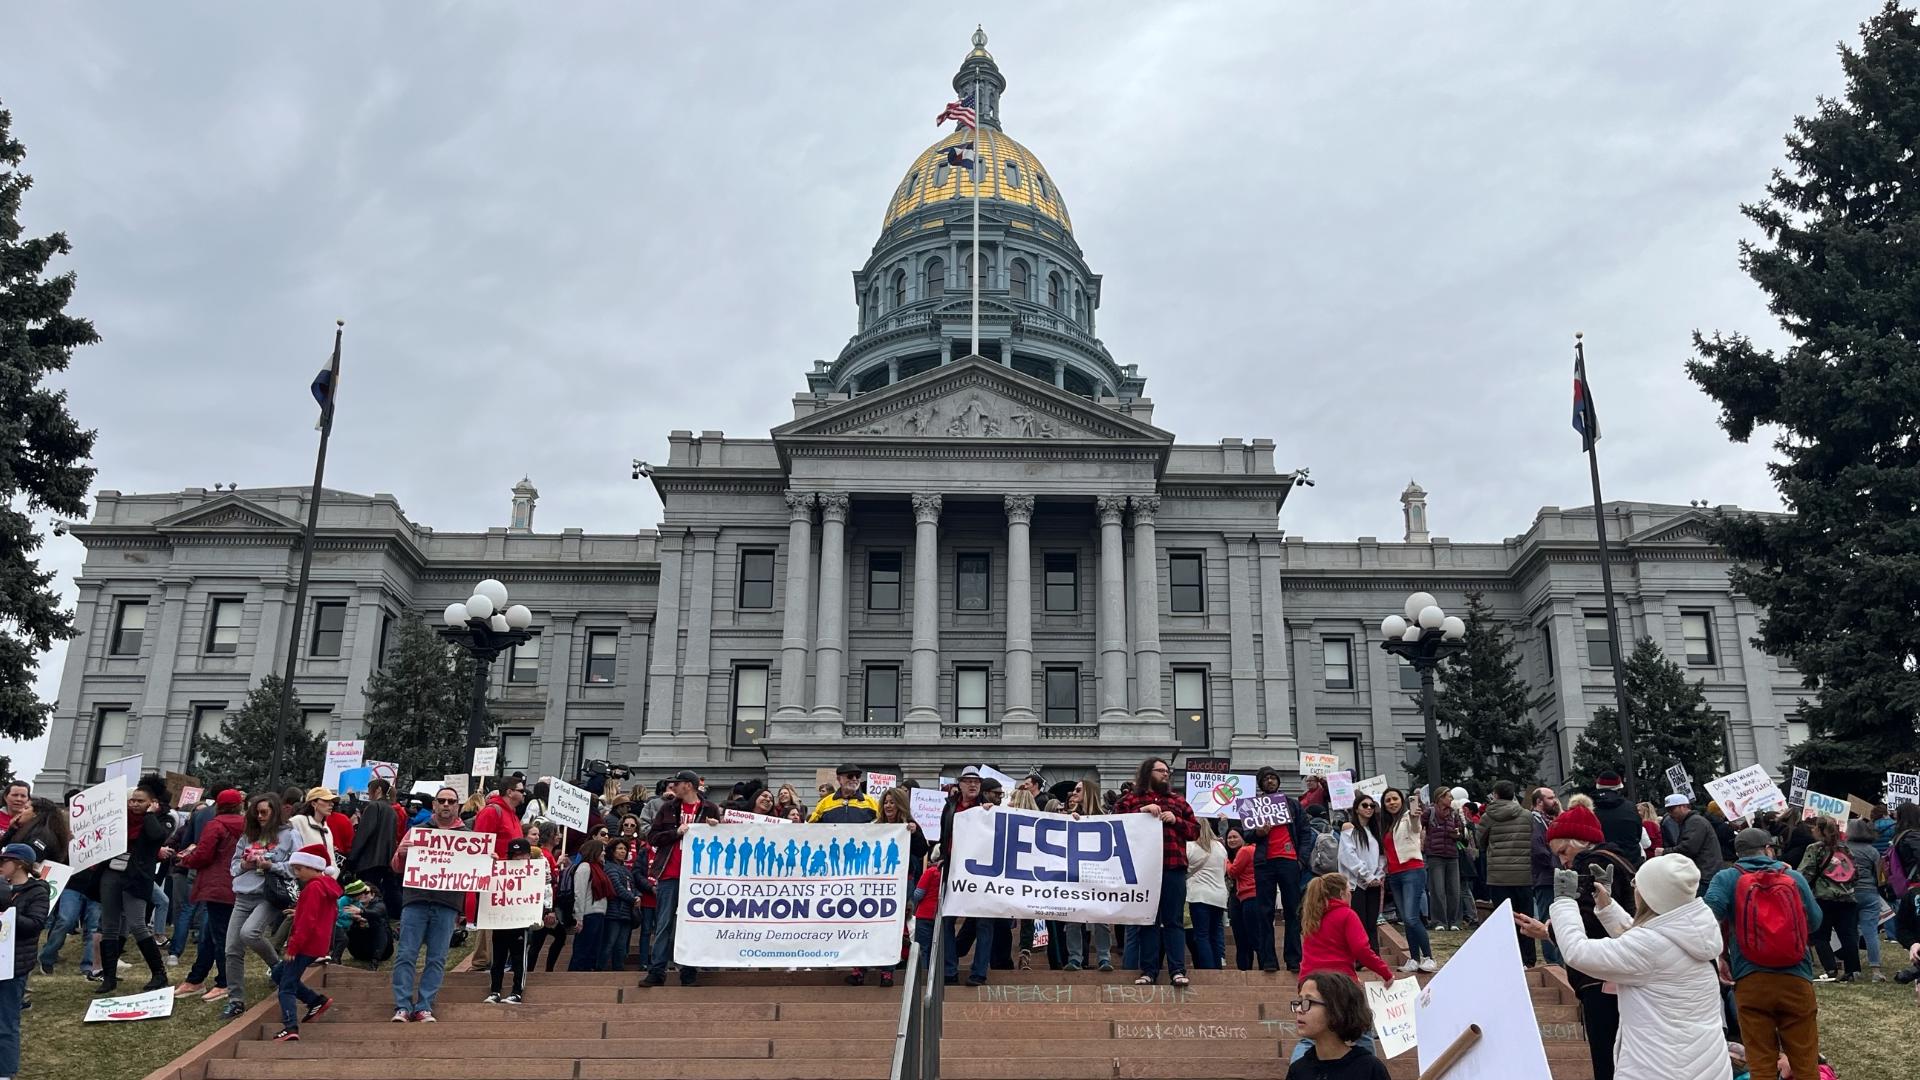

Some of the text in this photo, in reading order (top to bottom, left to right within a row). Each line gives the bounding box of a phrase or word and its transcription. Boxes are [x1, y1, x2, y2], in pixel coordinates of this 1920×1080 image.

[1187, 760, 1229, 771] Education
[1204, 774, 1226, 782] MORE
[1890, 774, 1917, 787] TABOR
[1889, 783, 1919, 796] STEALS
[1251, 802, 1288, 817] MORE
[1253, 796, 1272, 808] NO
[1809, 794, 1845, 814] FUND
[550, 806, 583, 828] Democracy
[727, 810, 755, 821] Schools
[1244, 811, 1291, 829] CUTS!
[413, 829, 493, 855] Invest
[965, 812, 1138, 884] JESPA
[419, 855, 428, 863] of
[492, 860, 540, 877] Educate
[496, 876, 526, 891] NOT
[689, 882, 897, 897] COLORADANS FOR THE
[952, 879, 1150, 903] We Are Professionals!
[687, 898, 898, 919] COMMON GOOD
[716, 929, 869, 942] Making Democracy Work
[739, 949, 840, 958] COCommonGood.org
[978, 984, 1200, 1003] IMPEACH TRUMP
[1369, 987, 1408, 1003] More
[1386, 1002, 1407, 1020] NOT
[1198, 1023, 1248, 1039] RIGHTS
[1382, 1022, 1411, 1037] Less
